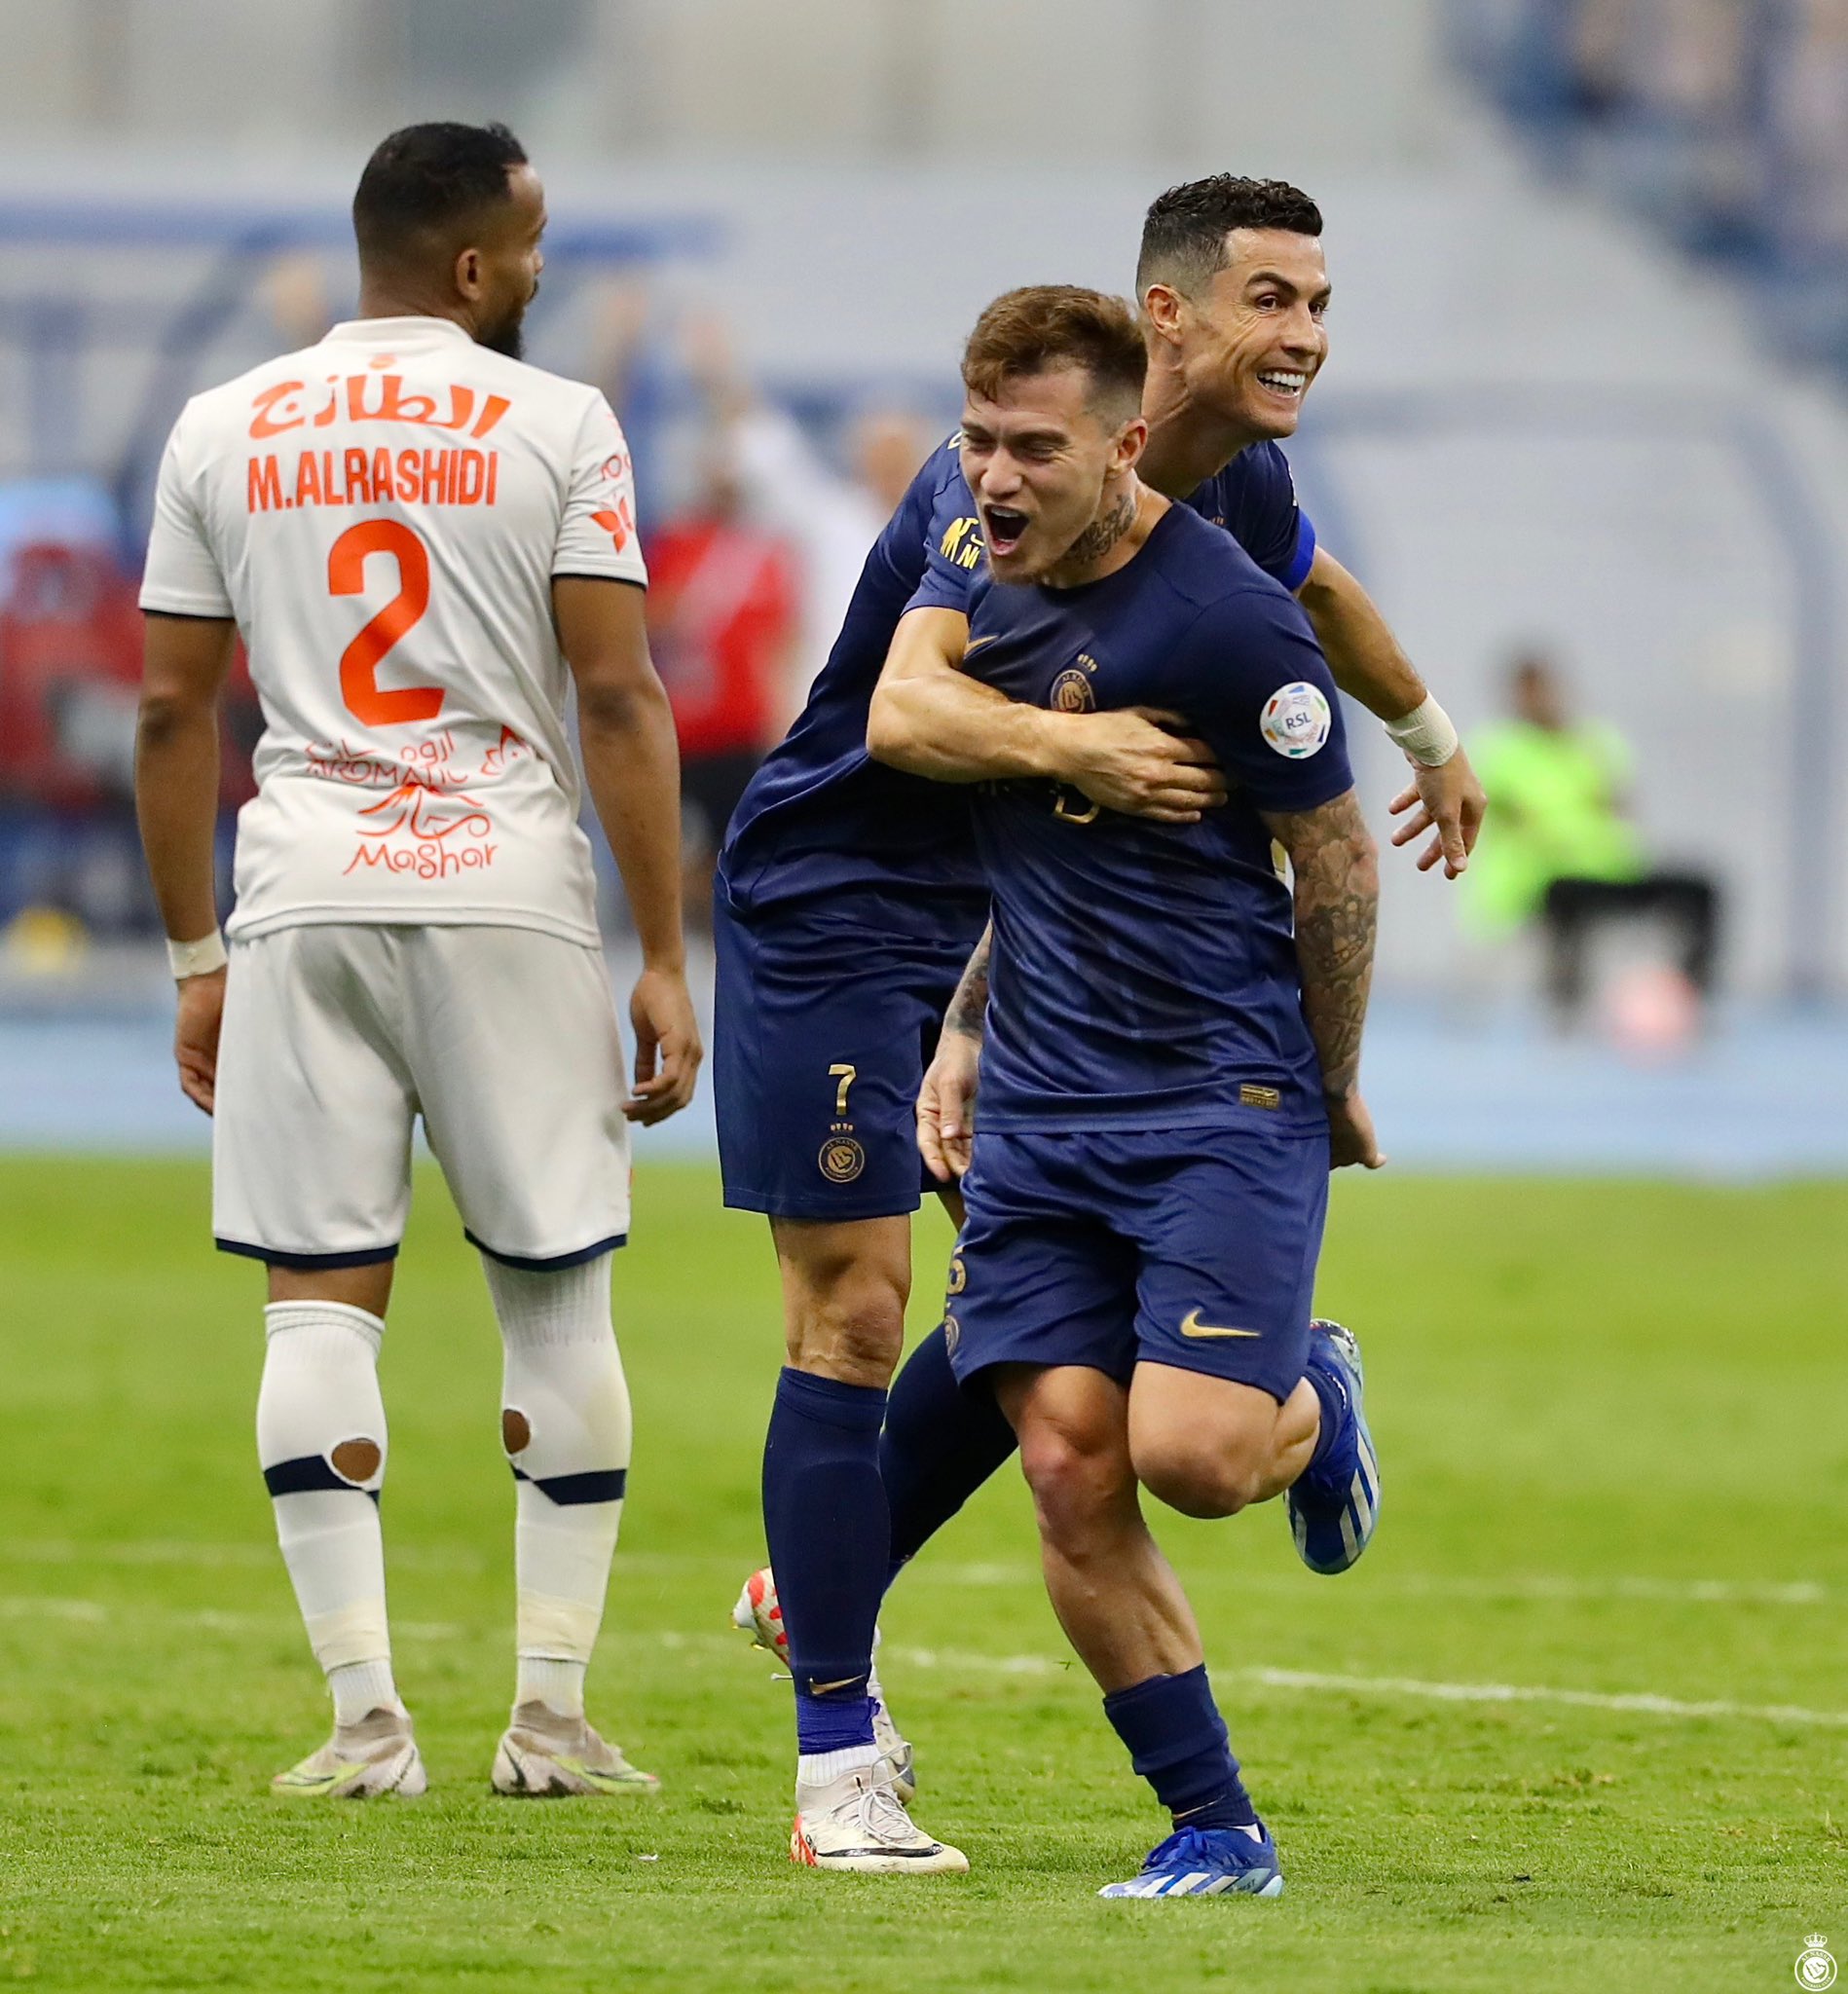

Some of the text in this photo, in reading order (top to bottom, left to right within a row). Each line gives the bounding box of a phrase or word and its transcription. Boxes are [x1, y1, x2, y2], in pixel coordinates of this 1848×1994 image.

[247, 447, 499, 514] M.ALRASHIDI
[327, 518, 445, 727] 2
[1285, 712, 1312, 730] RSL
[829, 1064, 857, 1115] 7
